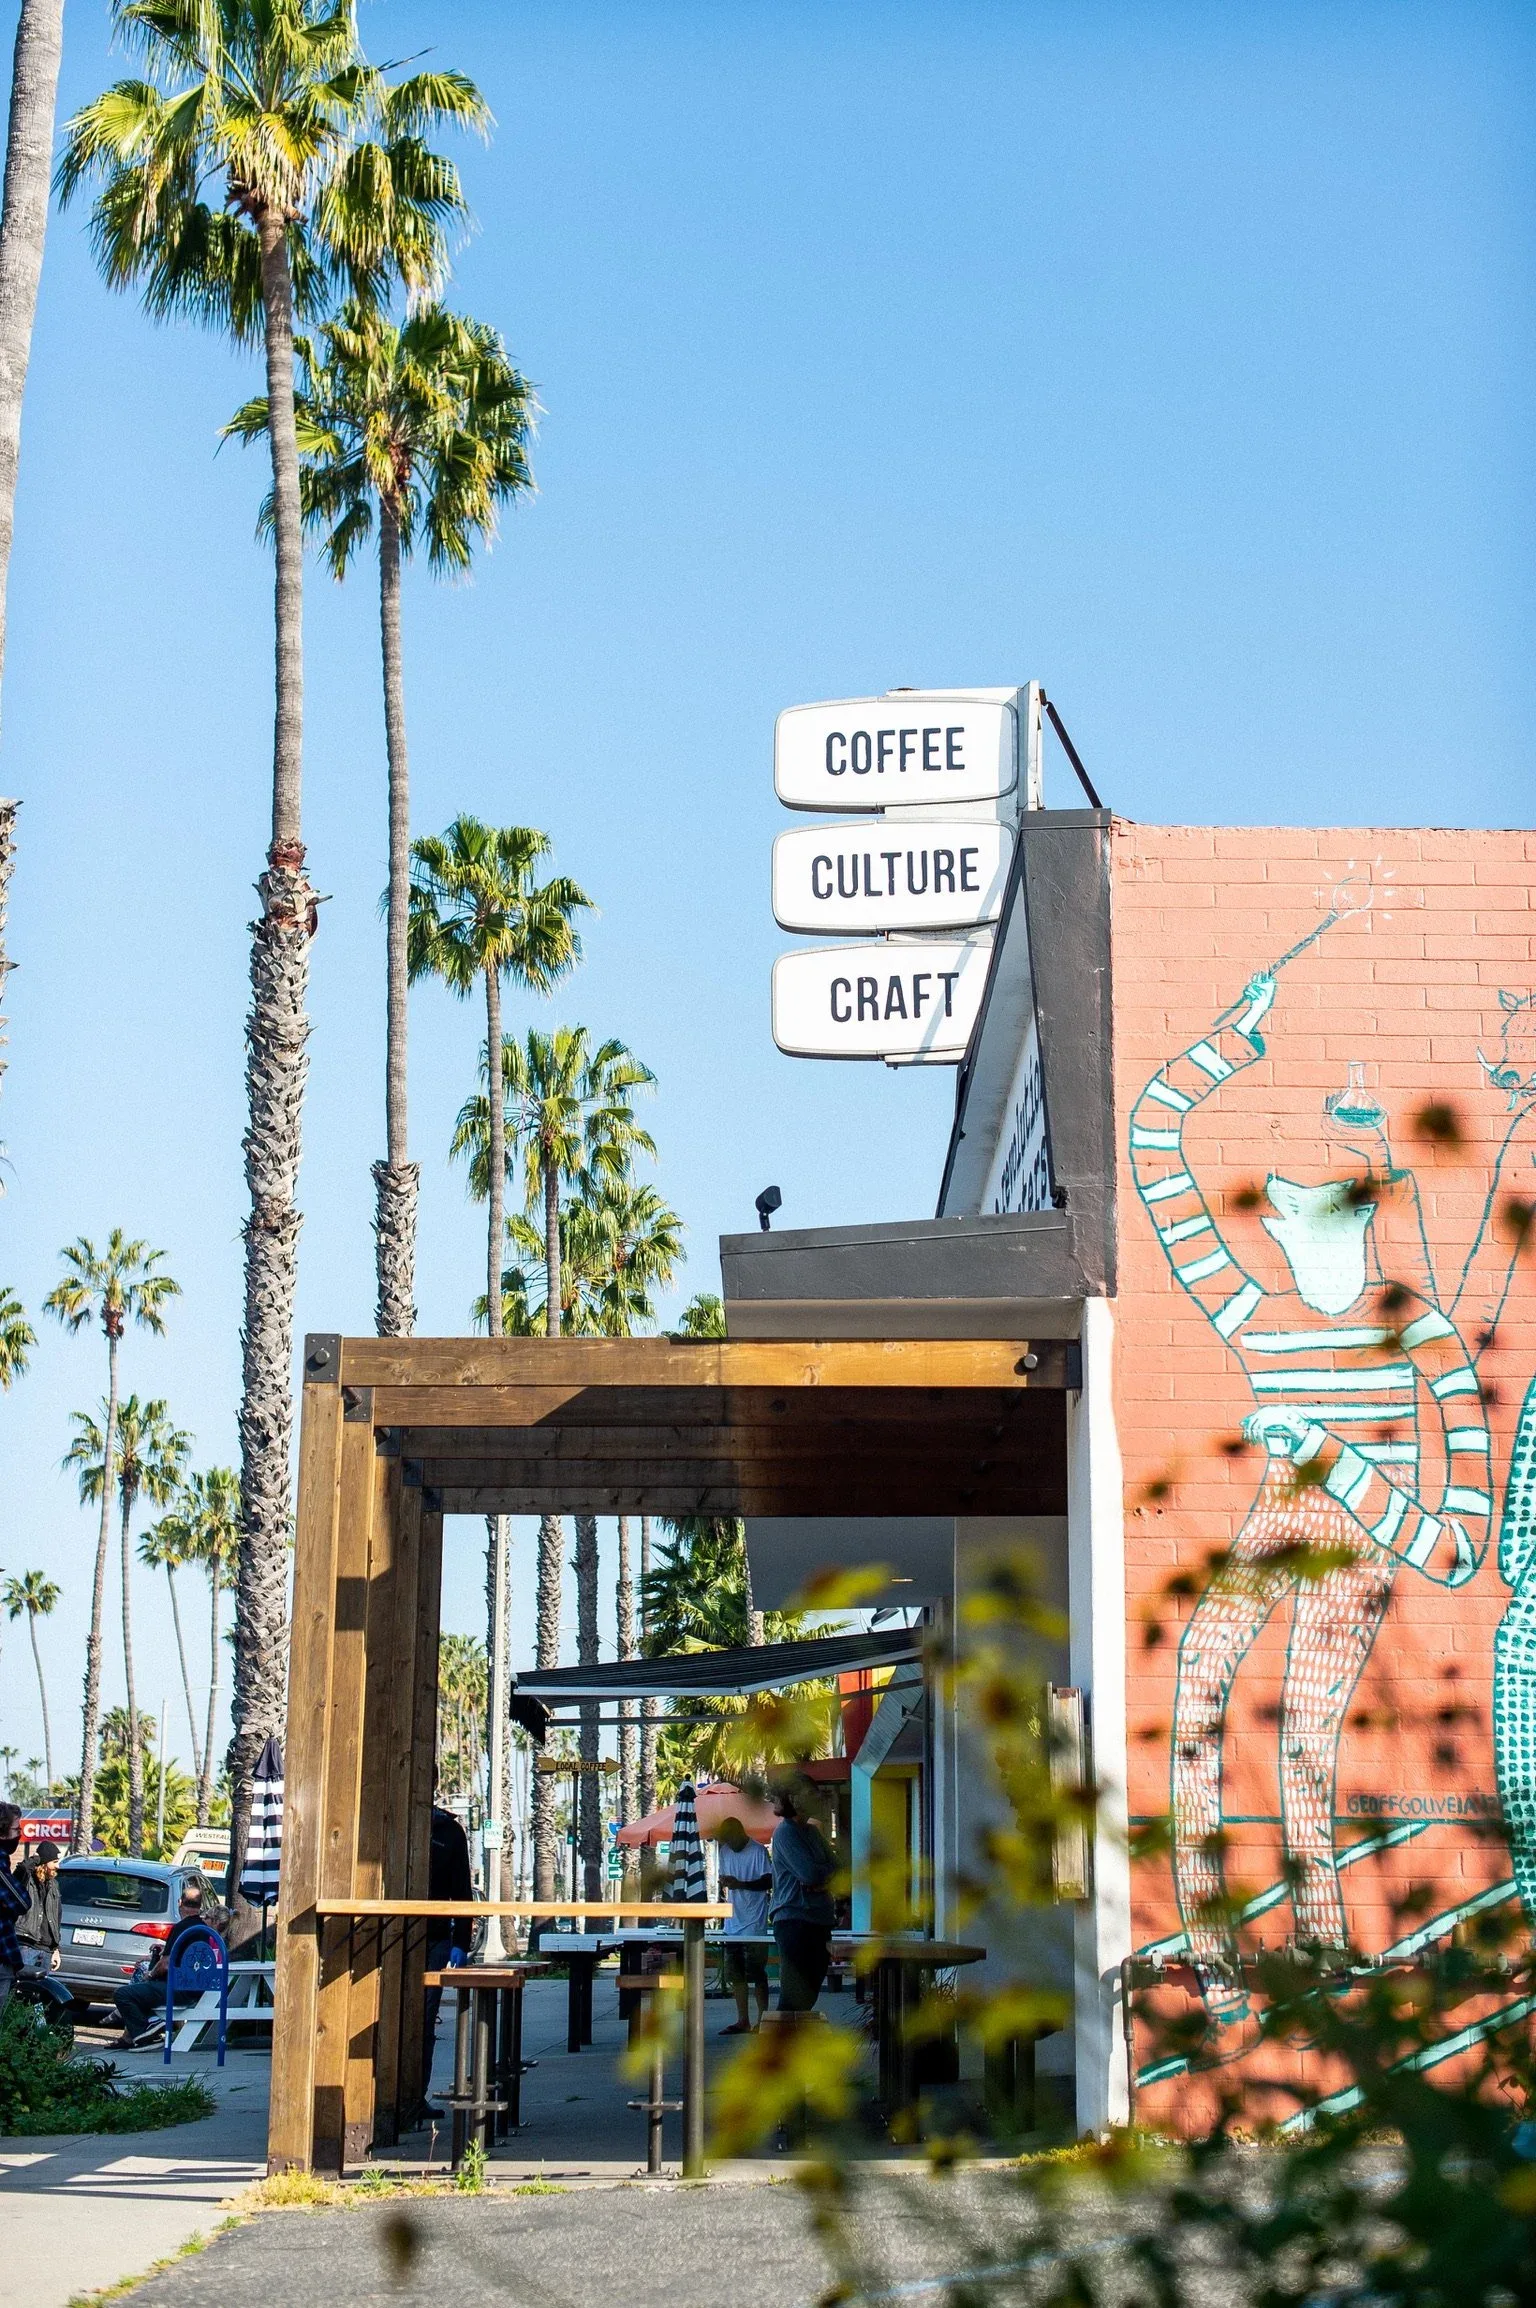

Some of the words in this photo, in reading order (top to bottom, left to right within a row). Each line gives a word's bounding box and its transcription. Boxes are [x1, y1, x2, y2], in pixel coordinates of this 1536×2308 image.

[825, 726, 966, 776] COFFEE
[811, 847, 980, 899] CULTURE
[830, 972, 960, 1023] CRAFT
[1001, 1054, 1044, 1213] revolutio
[556, 1762, 578, 1770] LOCAL
[581, 1762, 606, 1771] COFFEE
[23, 1823, 70, 1838] CIRCL
